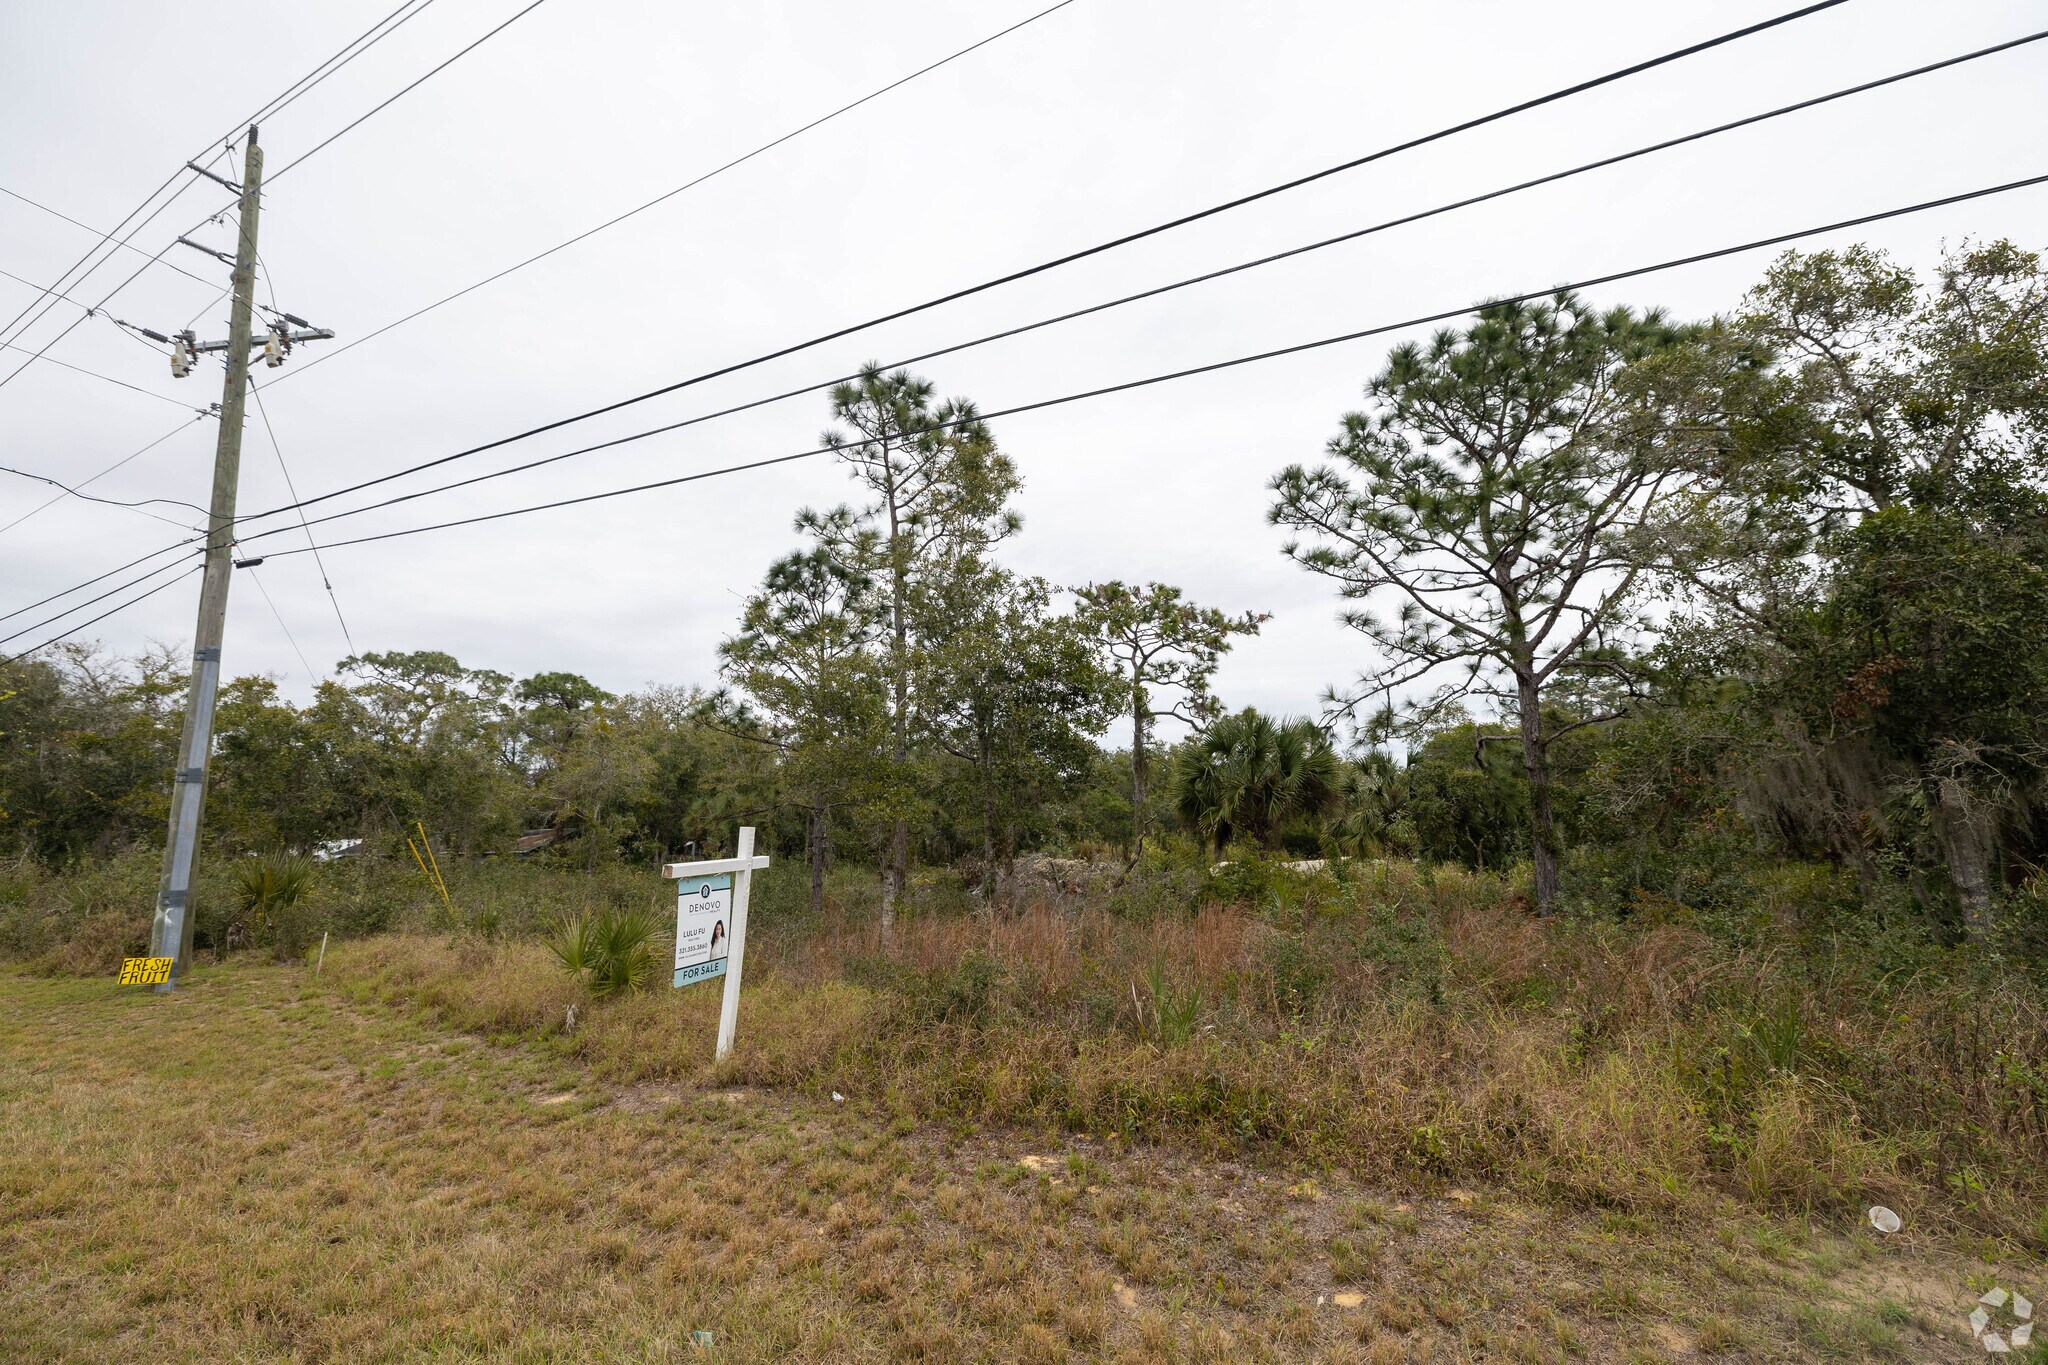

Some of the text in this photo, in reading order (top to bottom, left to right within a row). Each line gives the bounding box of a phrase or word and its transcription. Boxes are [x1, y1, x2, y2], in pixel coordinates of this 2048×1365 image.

[689, 900, 721, 913] DENOVO
[683, 927, 706, 938] LULU FU
[123, 958, 171, 971] FRESH
[683, 962, 719, 980] FOR SALE
[119, 970, 168, 984] FRUIT
